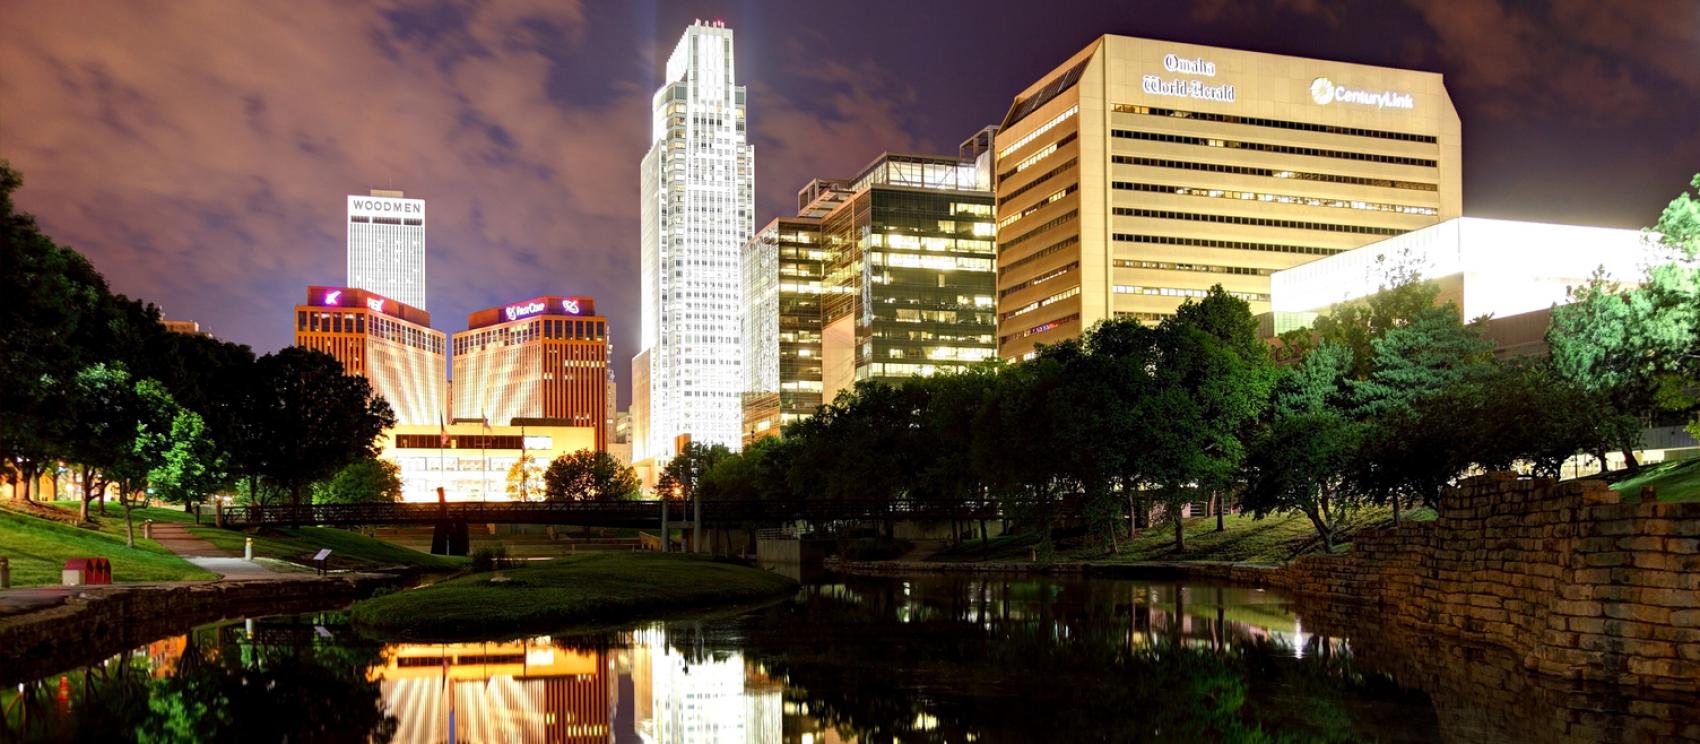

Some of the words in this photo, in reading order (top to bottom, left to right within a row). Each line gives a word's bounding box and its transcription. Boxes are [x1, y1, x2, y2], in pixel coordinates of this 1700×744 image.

[1164, 54, 1216, 76] Omaha
[1335, 85, 1414, 109] CenturyLink
[353, 199, 421, 213] WOODMEN
